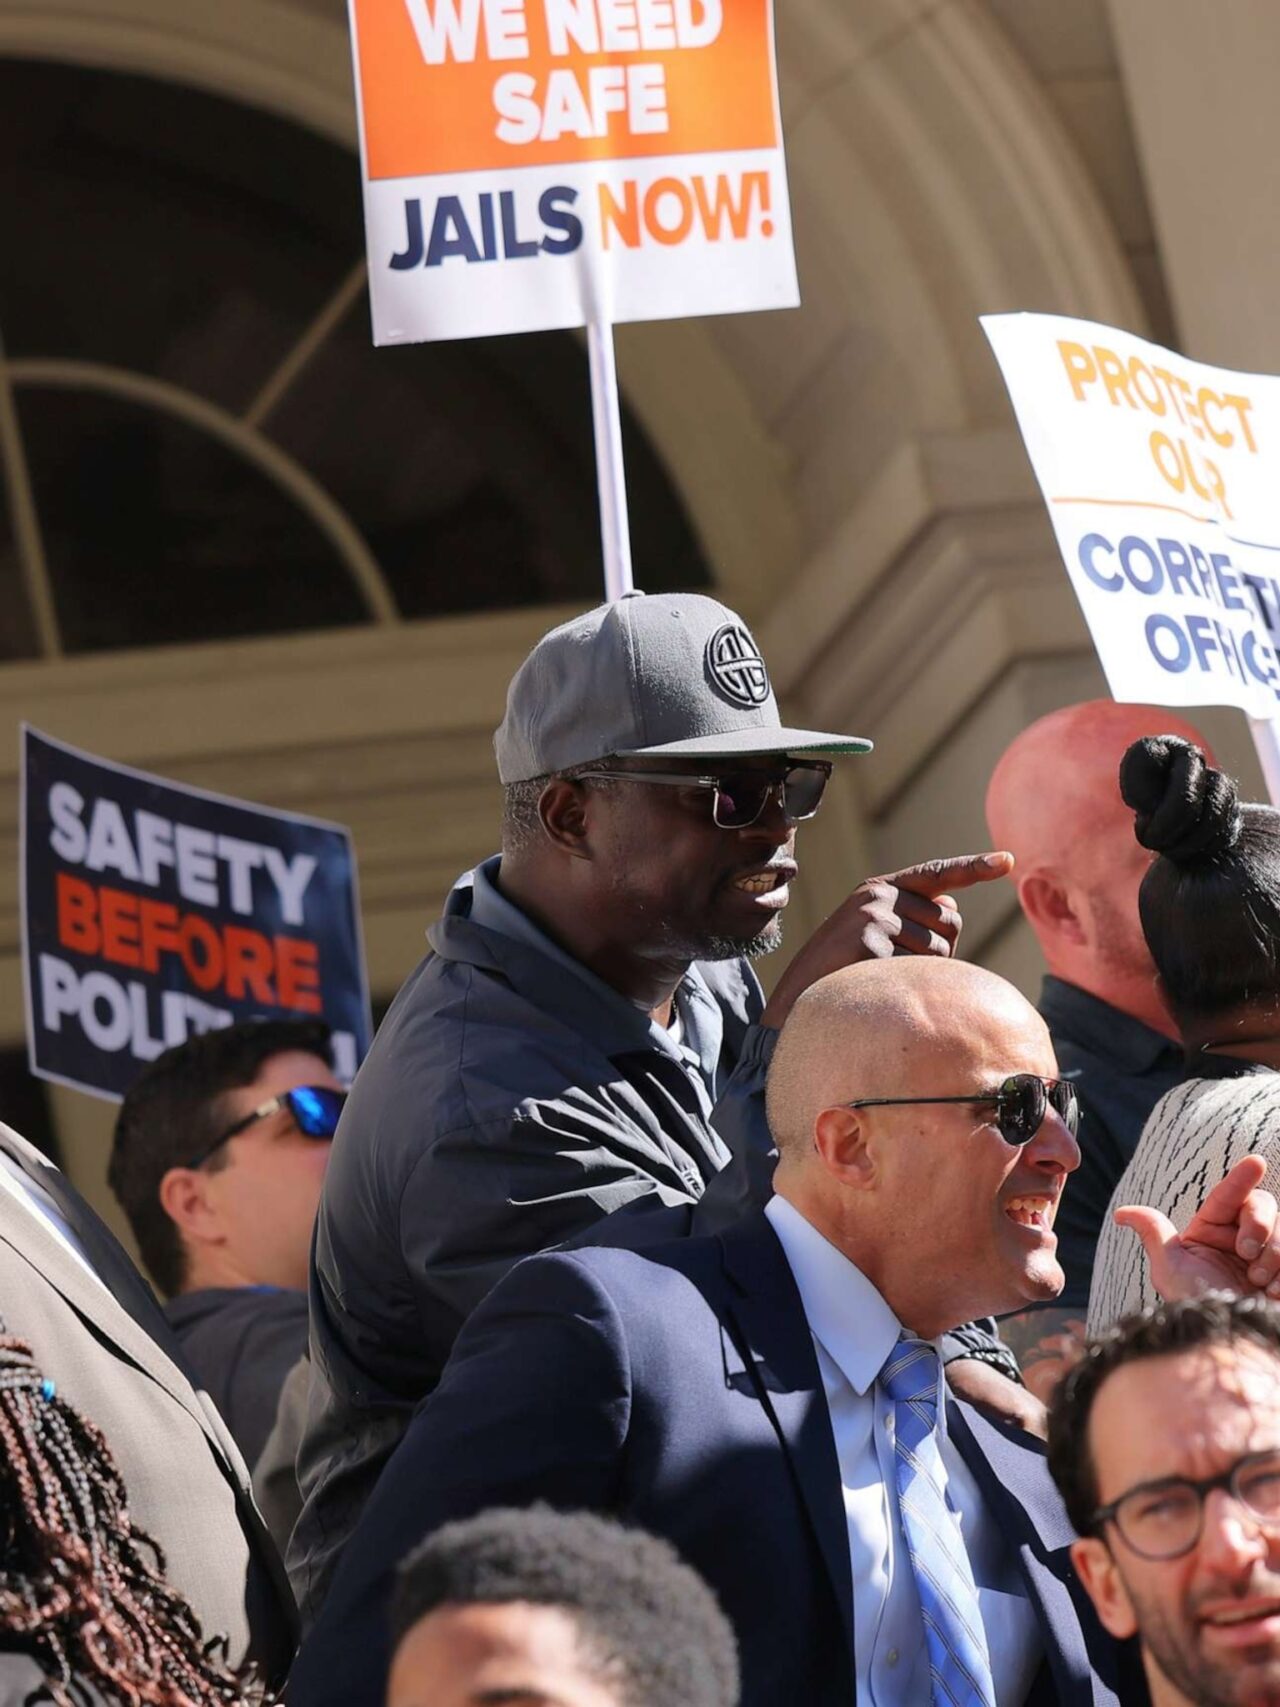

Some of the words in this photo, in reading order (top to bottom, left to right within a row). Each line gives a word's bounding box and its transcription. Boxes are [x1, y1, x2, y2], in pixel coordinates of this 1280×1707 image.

[406, 0, 529, 64] WE
[544, 0, 722, 55] NEED
[493, 63, 668, 144] SAFE
[389, 186, 583, 270] JAILS
[598, 171, 775, 250] NOW!
[48, 782, 318, 926] SAFETY
[54, 870, 323, 1014] BEFORE
